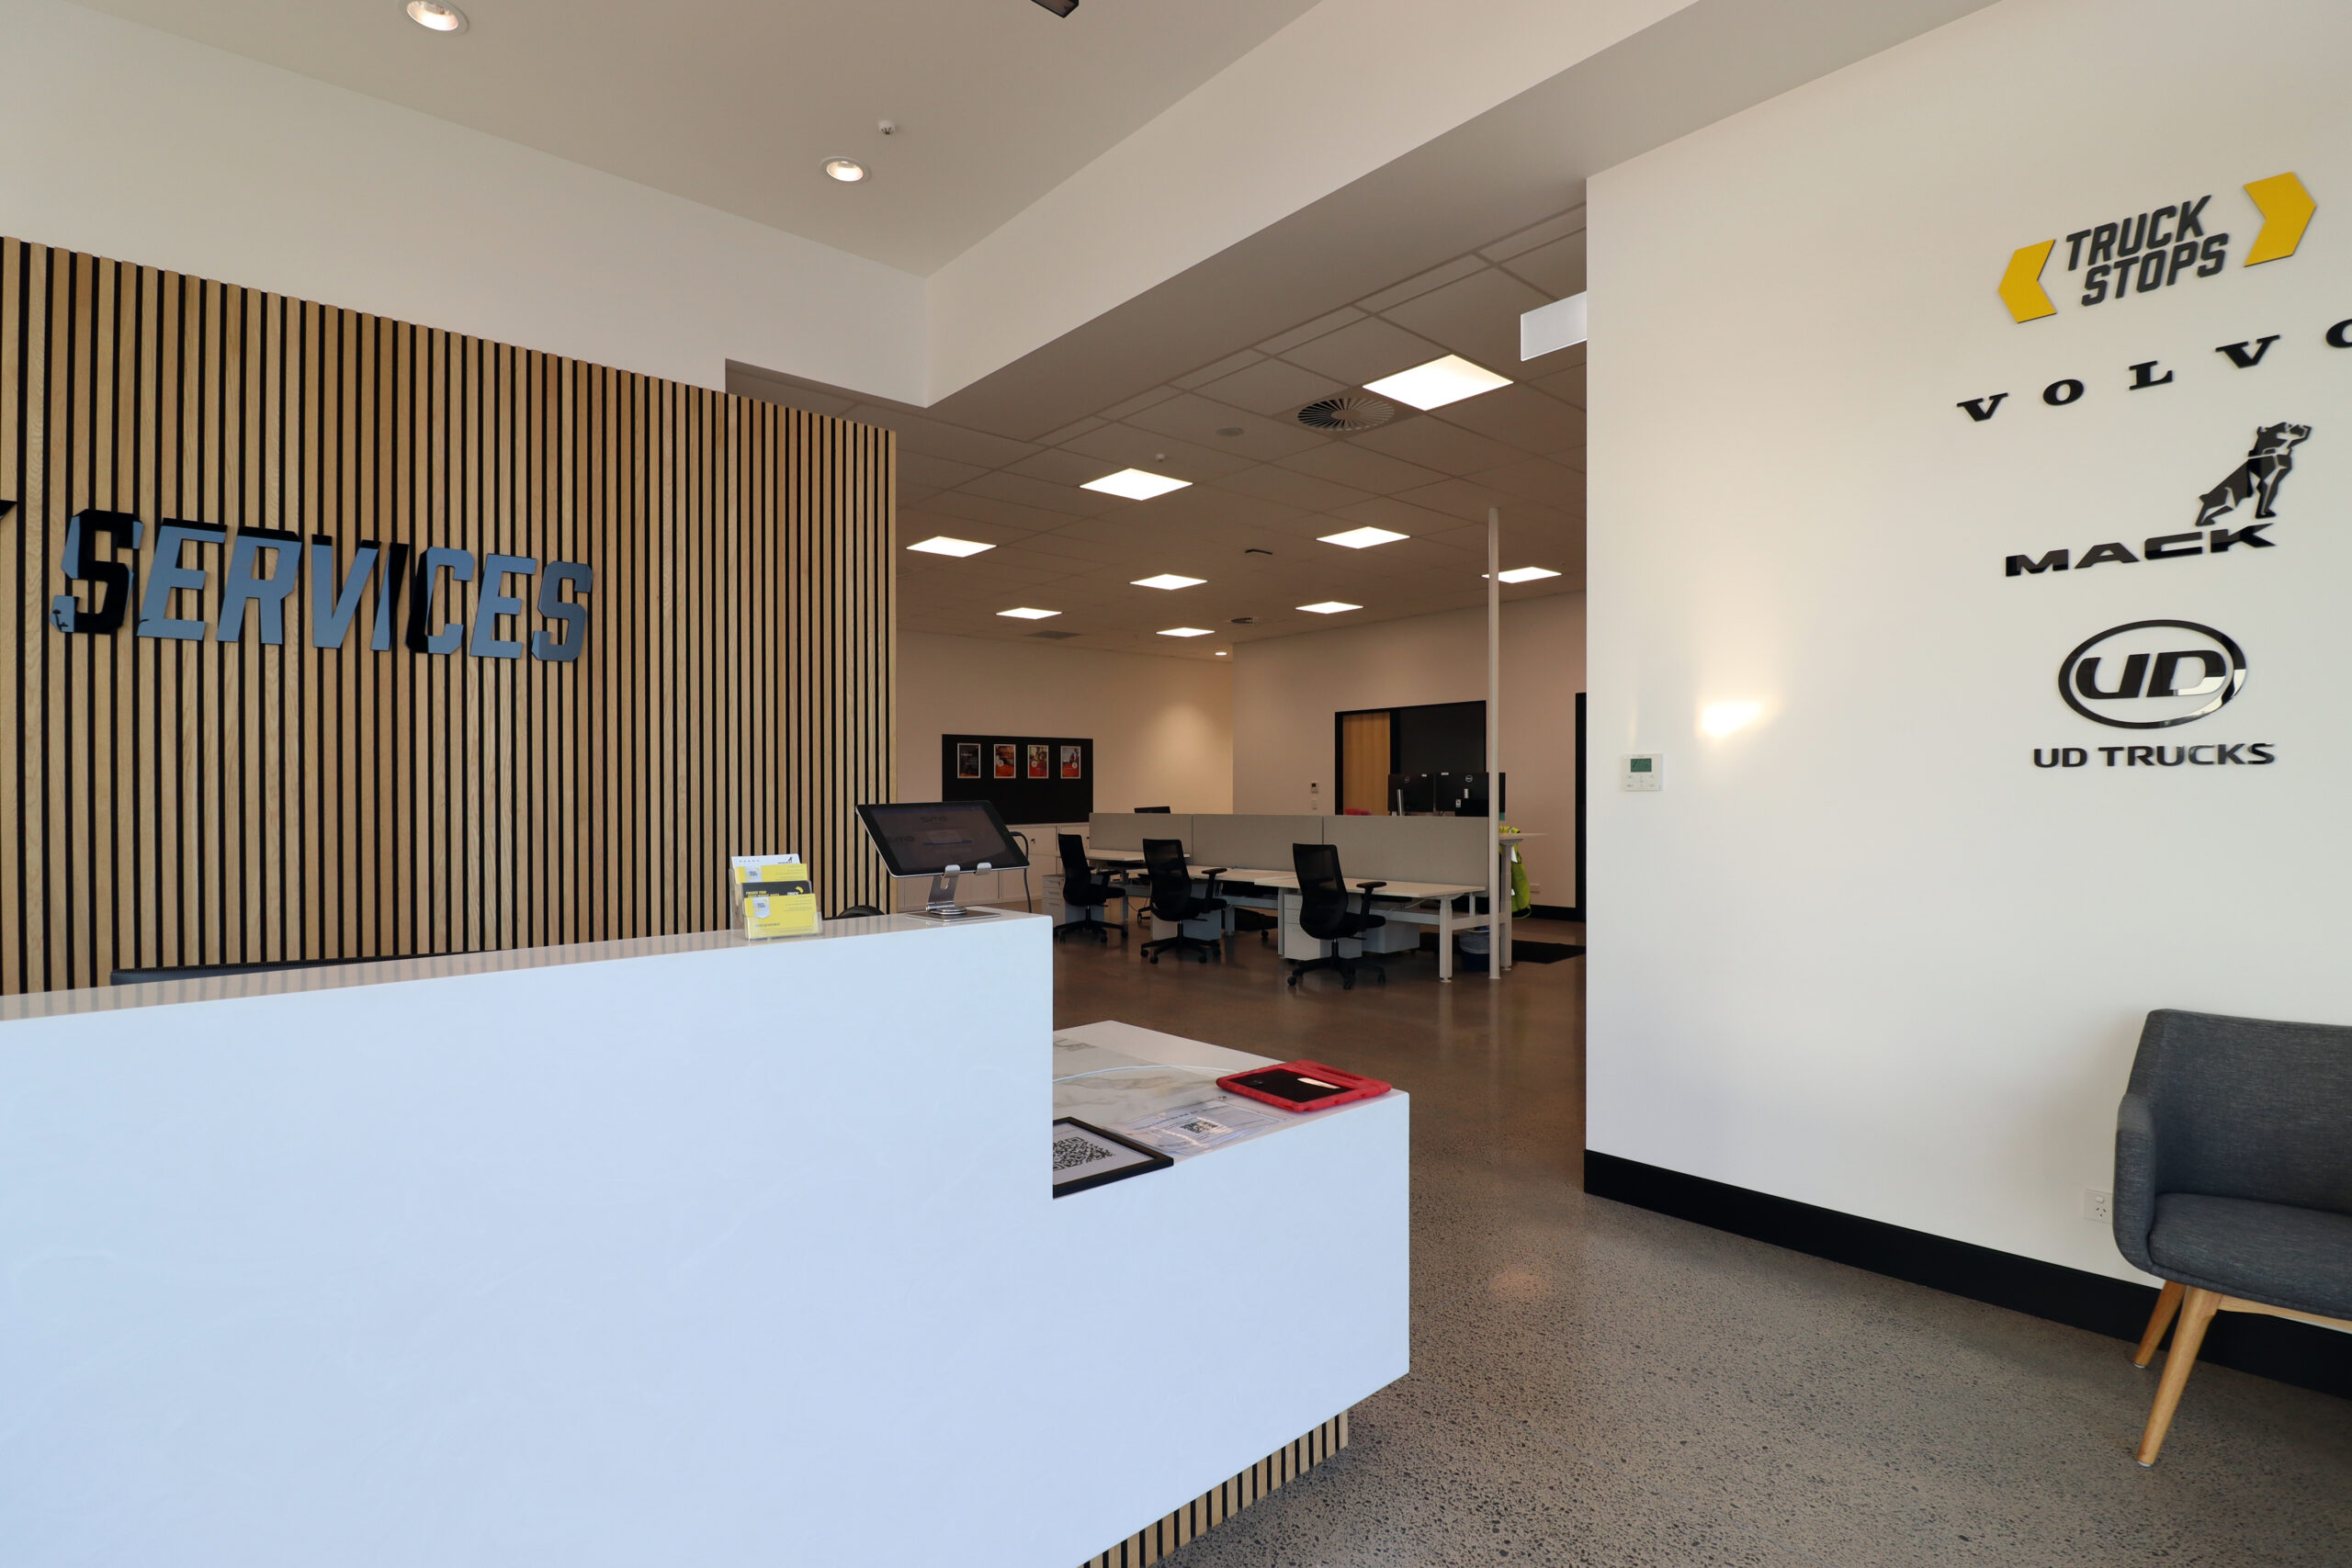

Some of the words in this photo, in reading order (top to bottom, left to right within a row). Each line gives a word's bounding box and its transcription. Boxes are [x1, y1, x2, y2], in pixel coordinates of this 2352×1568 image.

[2065, 194, 2211, 271] TRUCK
[2081, 232, 2230, 307] STOPS
[2006, 523, 2277, 577] MACK
[50, 508, 594, 662] SERVICES
[2075, 649, 2227, 700] UD
[2032, 747, 2088, 768] UD
[2098, 742, 2277, 767] TRUCKS
